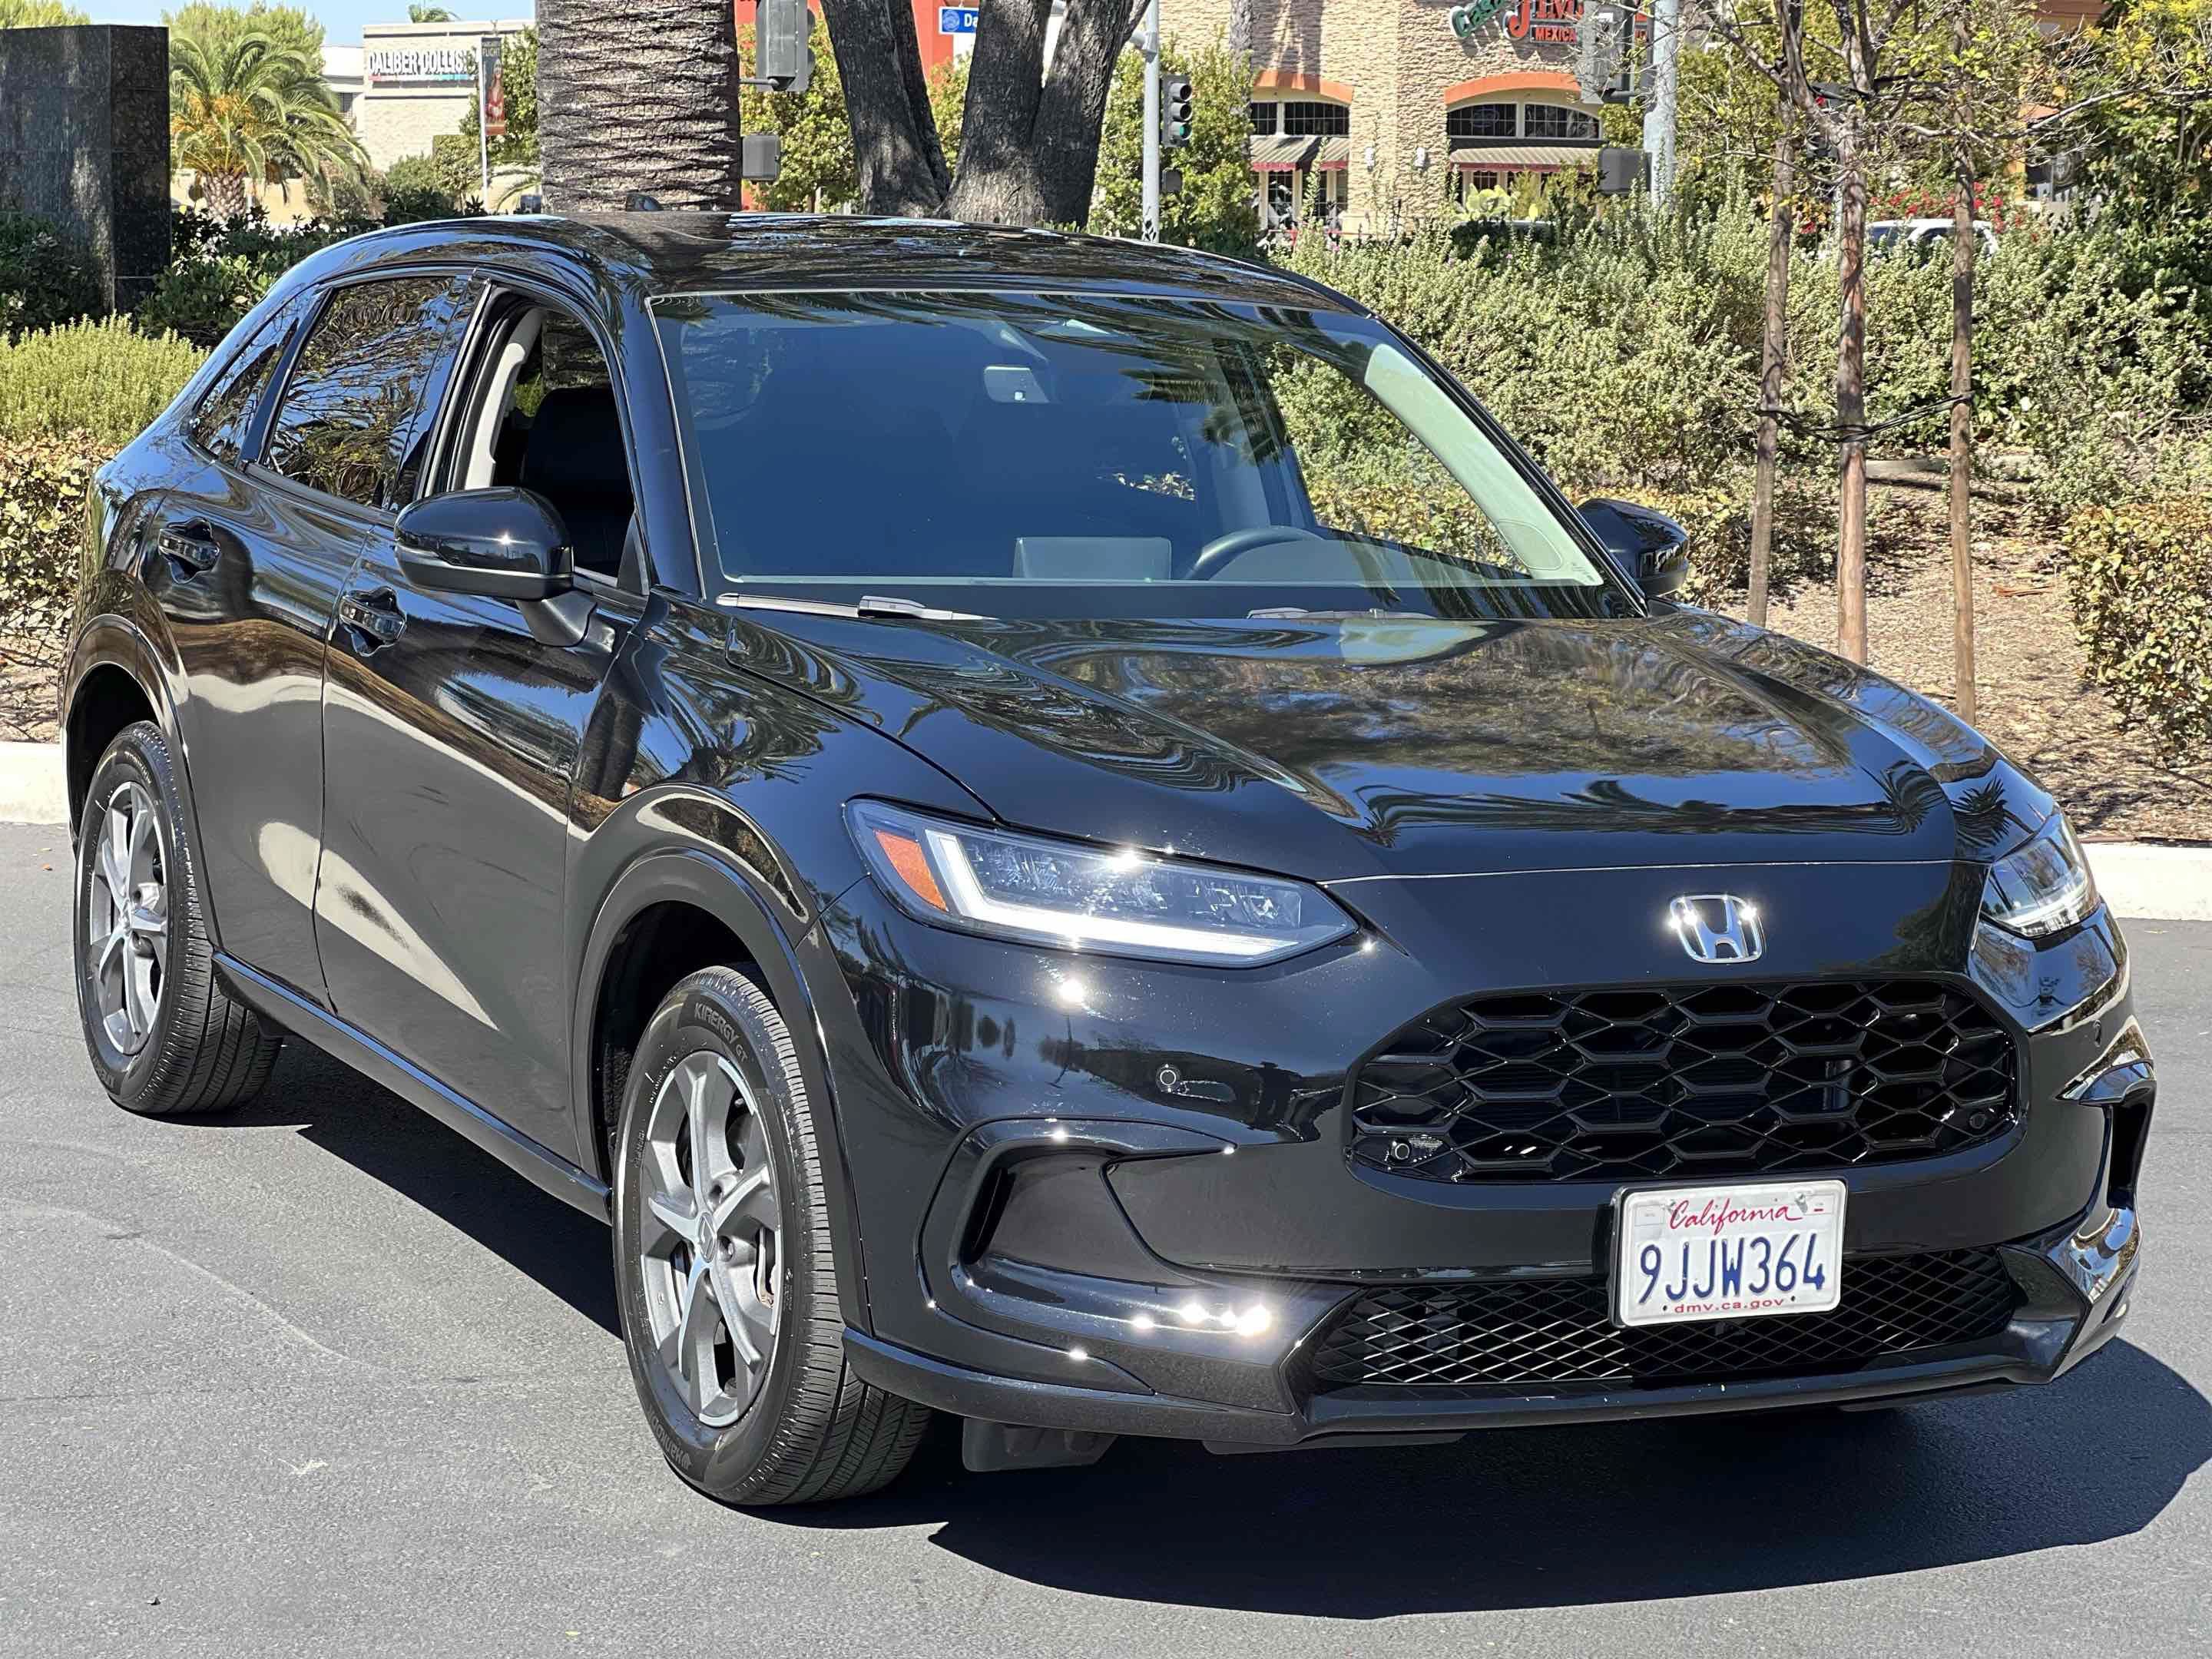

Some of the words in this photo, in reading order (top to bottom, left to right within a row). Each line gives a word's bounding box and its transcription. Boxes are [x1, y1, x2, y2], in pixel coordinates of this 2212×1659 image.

[964, 13, 979, 28] Da
[1535, 26, 1578, 43] MEXICA
[369, 49, 419, 75] CALIBER
[1669, 1198, 1803, 1235] California
[1637, 1233, 1826, 1304] 9JJW364
[1674, 1296, 1785, 1313] dmv.ca.gov
